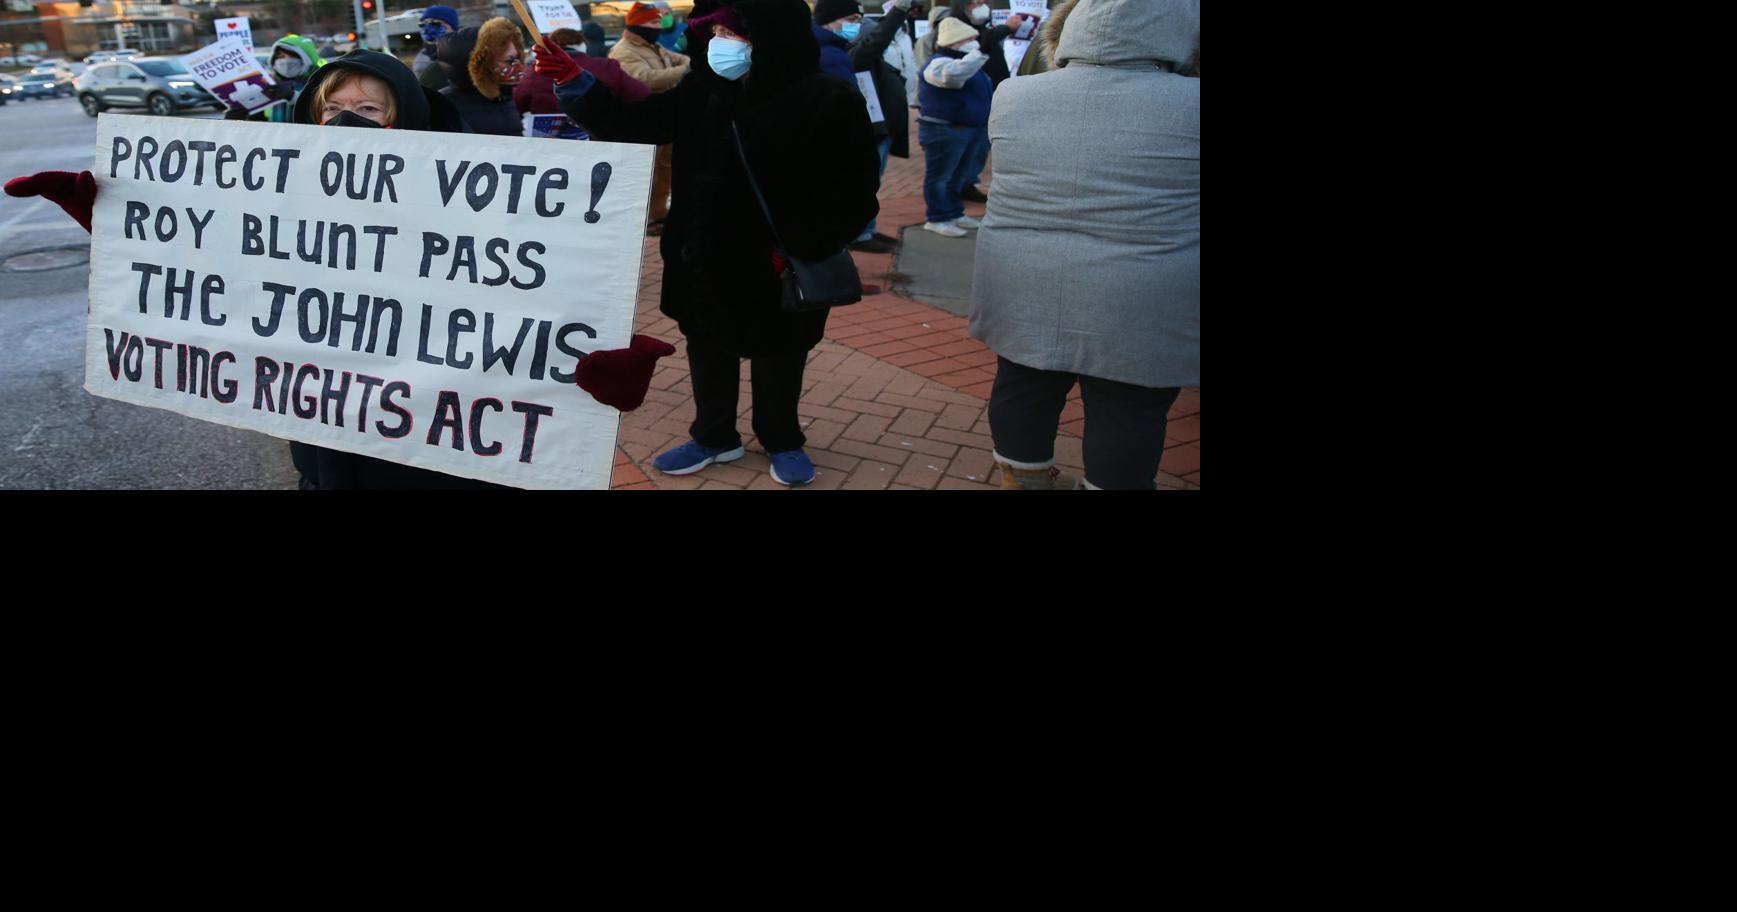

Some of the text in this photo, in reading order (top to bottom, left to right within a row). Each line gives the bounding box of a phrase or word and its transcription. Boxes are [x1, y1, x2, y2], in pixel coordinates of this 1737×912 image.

[193, 48, 242, 74] FREEDOM
[199, 70, 217, 80] TO
[216, 55, 248, 73] VOTE
[319, 152, 405, 204] OUR
[124, 201, 215, 250] ROY
[418, 232, 547, 290] PASS
[253, 355, 414, 440] RIGHTS
[425, 390, 555, 466] ACT
